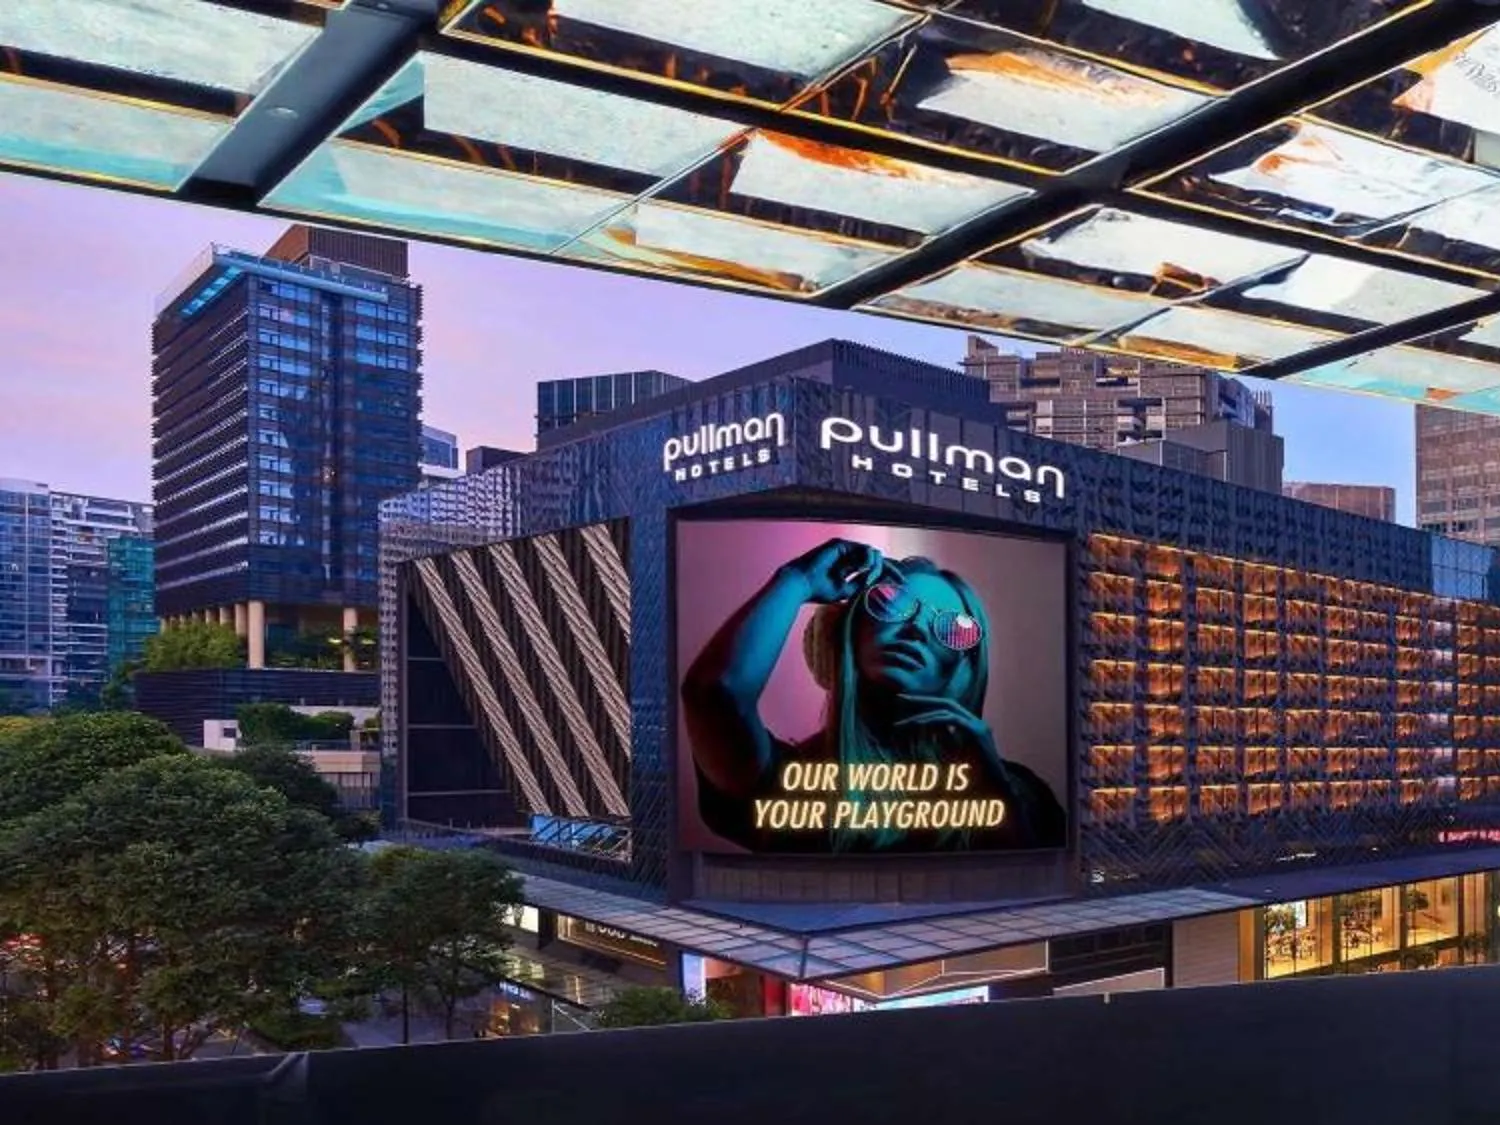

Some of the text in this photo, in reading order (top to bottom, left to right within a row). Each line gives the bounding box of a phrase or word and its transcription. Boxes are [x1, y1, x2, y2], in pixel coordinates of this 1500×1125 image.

[664, 412, 785, 472] pullman
[820, 417, 1065, 499] pullman
[675, 448, 771, 482] HOTELS
[852, 454, 1041, 503] HOTELS
[783, 763, 973, 792] OUR WORLD IS
[755, 799, 1005, 829] YOUR PLAYGROUND
